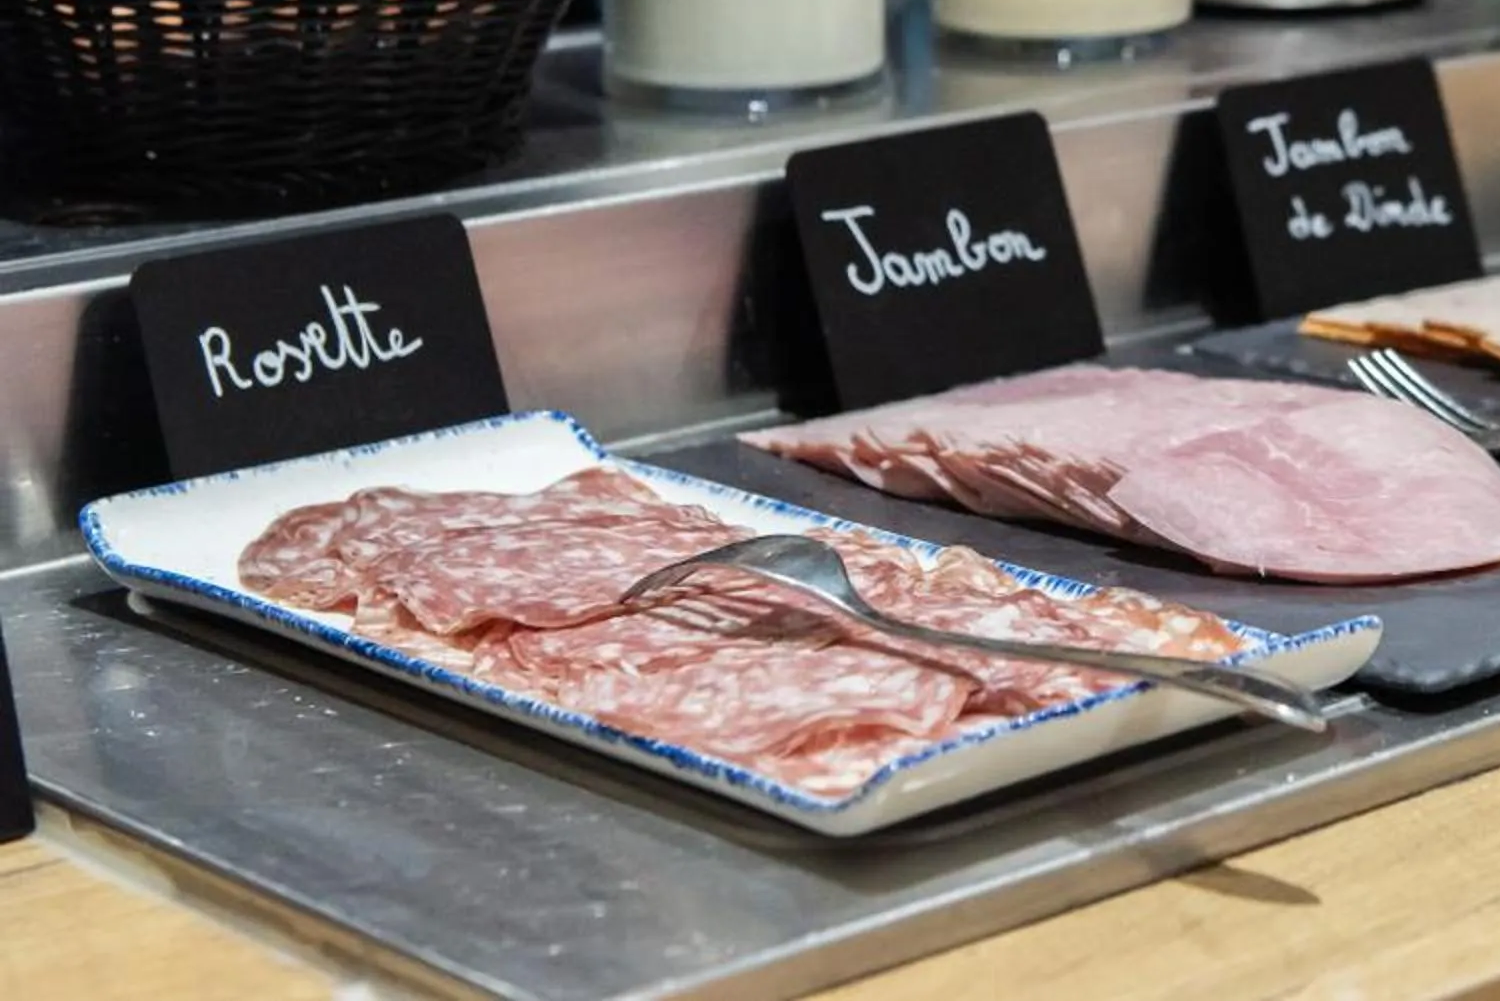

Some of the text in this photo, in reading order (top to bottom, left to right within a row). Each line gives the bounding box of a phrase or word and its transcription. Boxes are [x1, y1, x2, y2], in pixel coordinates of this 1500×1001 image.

[1246, 108, 1413, 177] Jambon
[1287, 176, 1453, 240] de Dinde
[820, 205, 1047, 295] Jambon
[198, 284, 424, 397] Rosette
